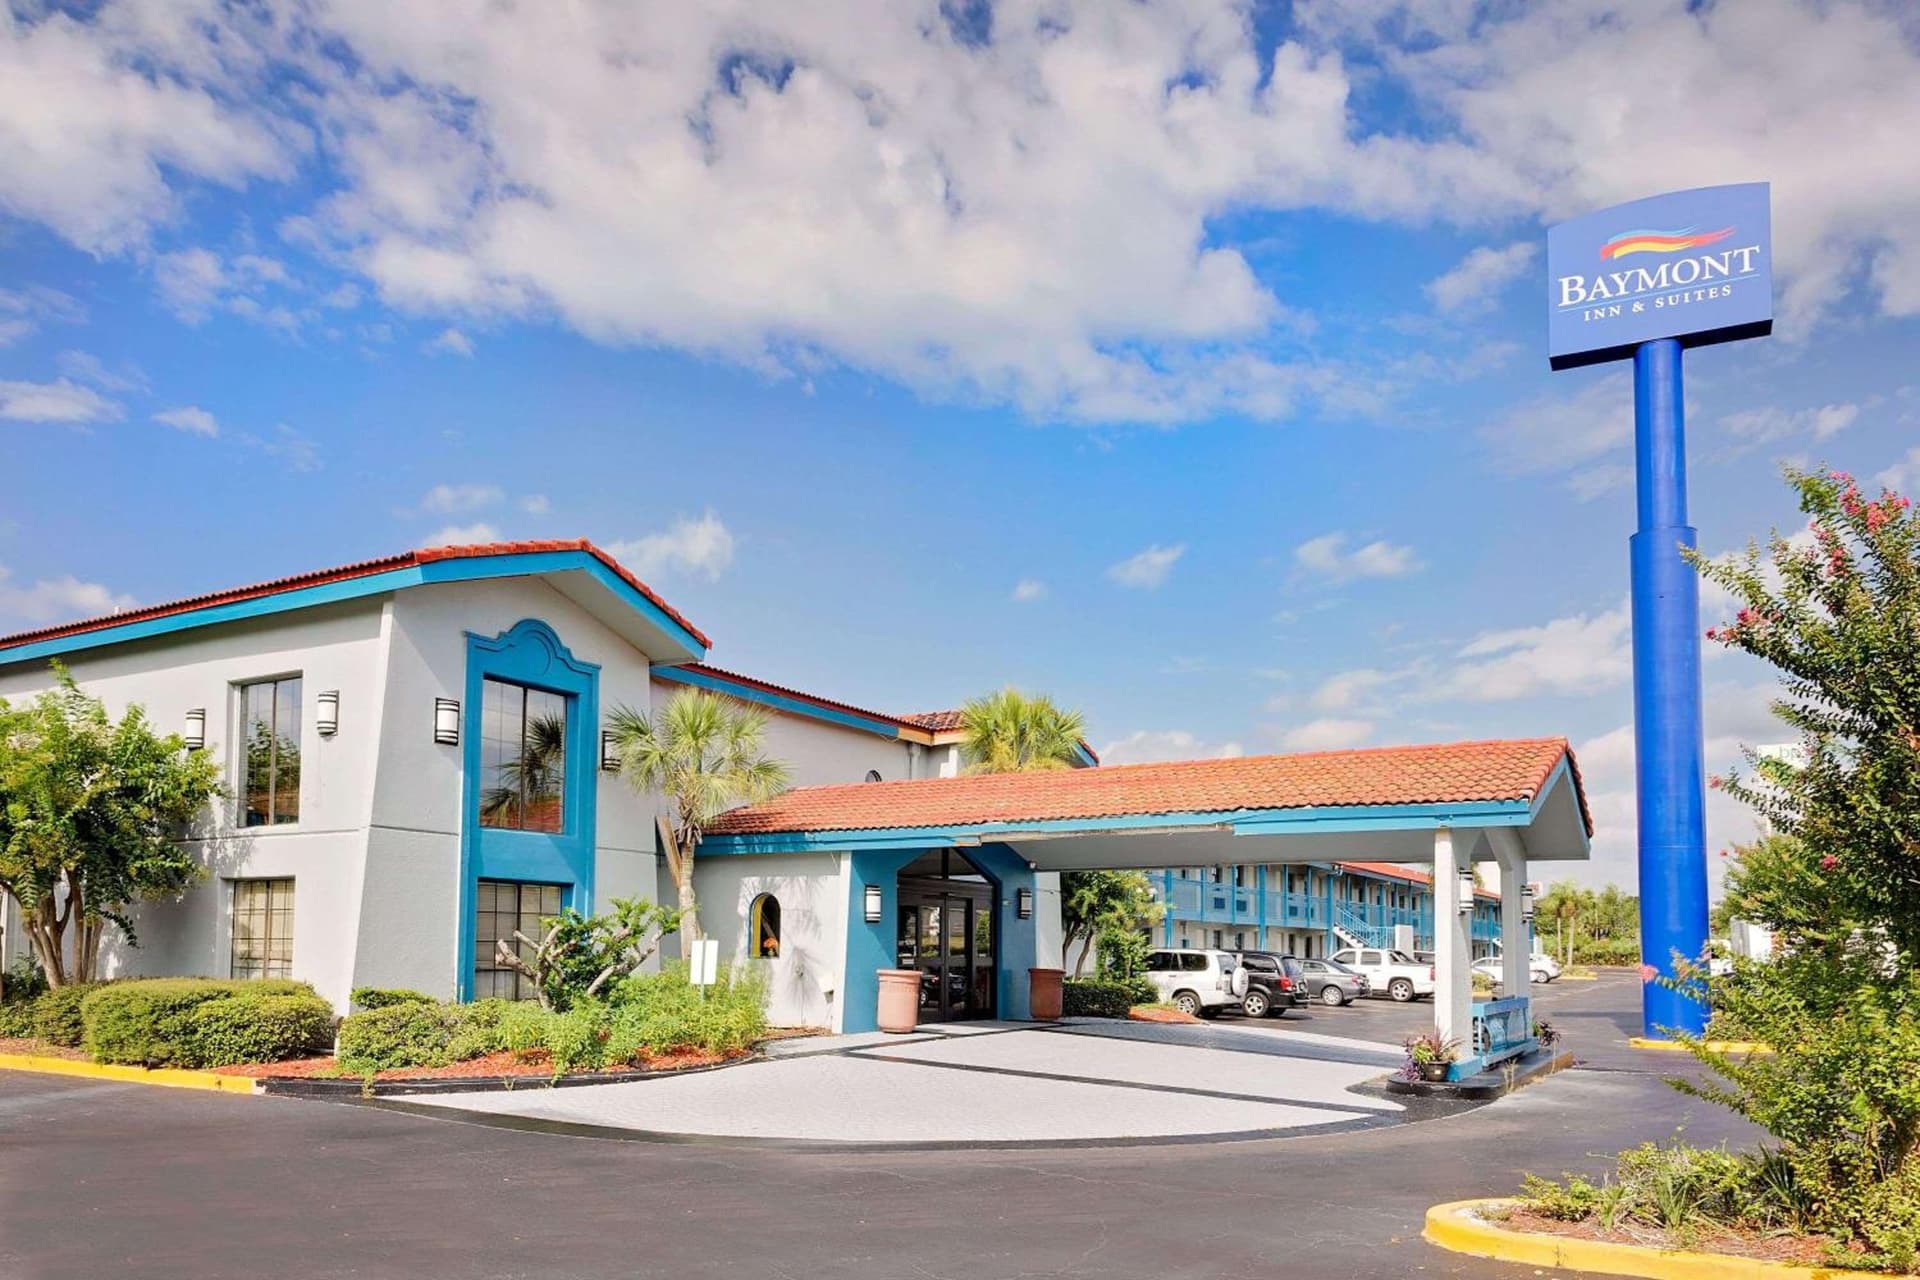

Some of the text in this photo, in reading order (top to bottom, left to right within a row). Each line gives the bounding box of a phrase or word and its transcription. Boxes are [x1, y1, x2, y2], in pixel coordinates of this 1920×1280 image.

[1558, 245, 1761, 307] BAYMONT
[1584, 284, 1732, 322] INN & SUITES
